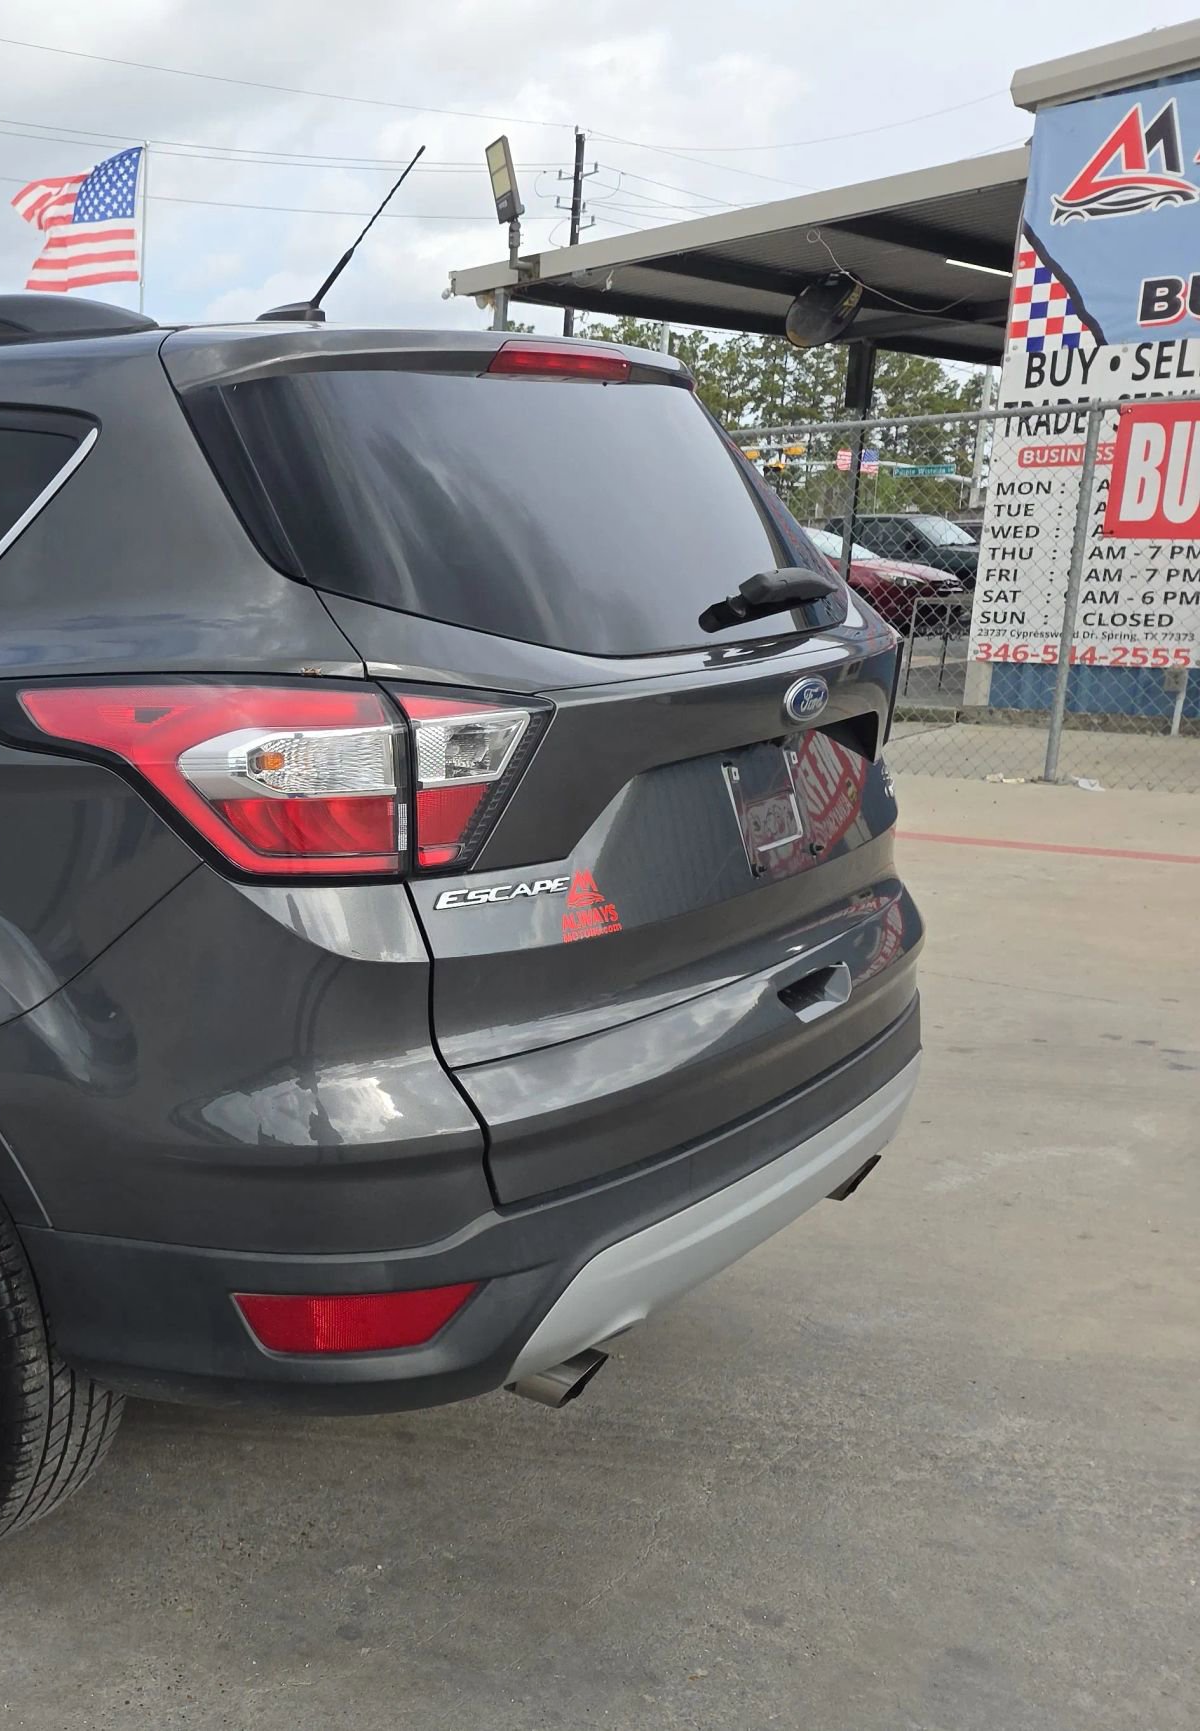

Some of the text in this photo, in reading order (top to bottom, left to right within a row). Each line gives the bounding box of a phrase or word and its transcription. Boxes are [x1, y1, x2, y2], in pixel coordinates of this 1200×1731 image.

[1137, 272, 1200, 328] B
[1025, 339, 1200, 388] BUY SEL
[1003, 397, 1090, 437] TRADE
[1022, 446, 1114, 465] BUSINSS
[1119, 421, 1200, 524] BU
[996, 481, 1052, 496] MON
[1097, 479, 1110, 493] A
[994, 503, 1035, 517] TUE
[1094, 502, 1107, 515] A
[990, 525, 1040, 539] WED
[1091, 524, 1104, 537] A
[988, 547, 1034, 560] THU
[1088, 546, 1126, 560] AM
[1148, 545, 1162, 560] 7
[1170, 545, 1200, 559] PM
[985, 568, 1018, 582] FRI
[1084, 568, 1123, 582] AM
[1145, 568, 1158, 582] 7
[1166, 568, 1200, 582] PM
[982, 590, 1022, 604] SAT
[1082, 590, 1119, 604] AM
[1141, 591, 1154, 605] 6
[1163, 591, 1200, 605] PM
[980, 611, 1025, 625] SUN
[1083, 612, 1174, 627] CLOSED
[1010, 629, 1079, 639] Cypresswd
[1144, 632, 1158, 640] TX
[434, 876, 571, 911] ESCAPE
[562, 903, 619, 932] ALWAYS
